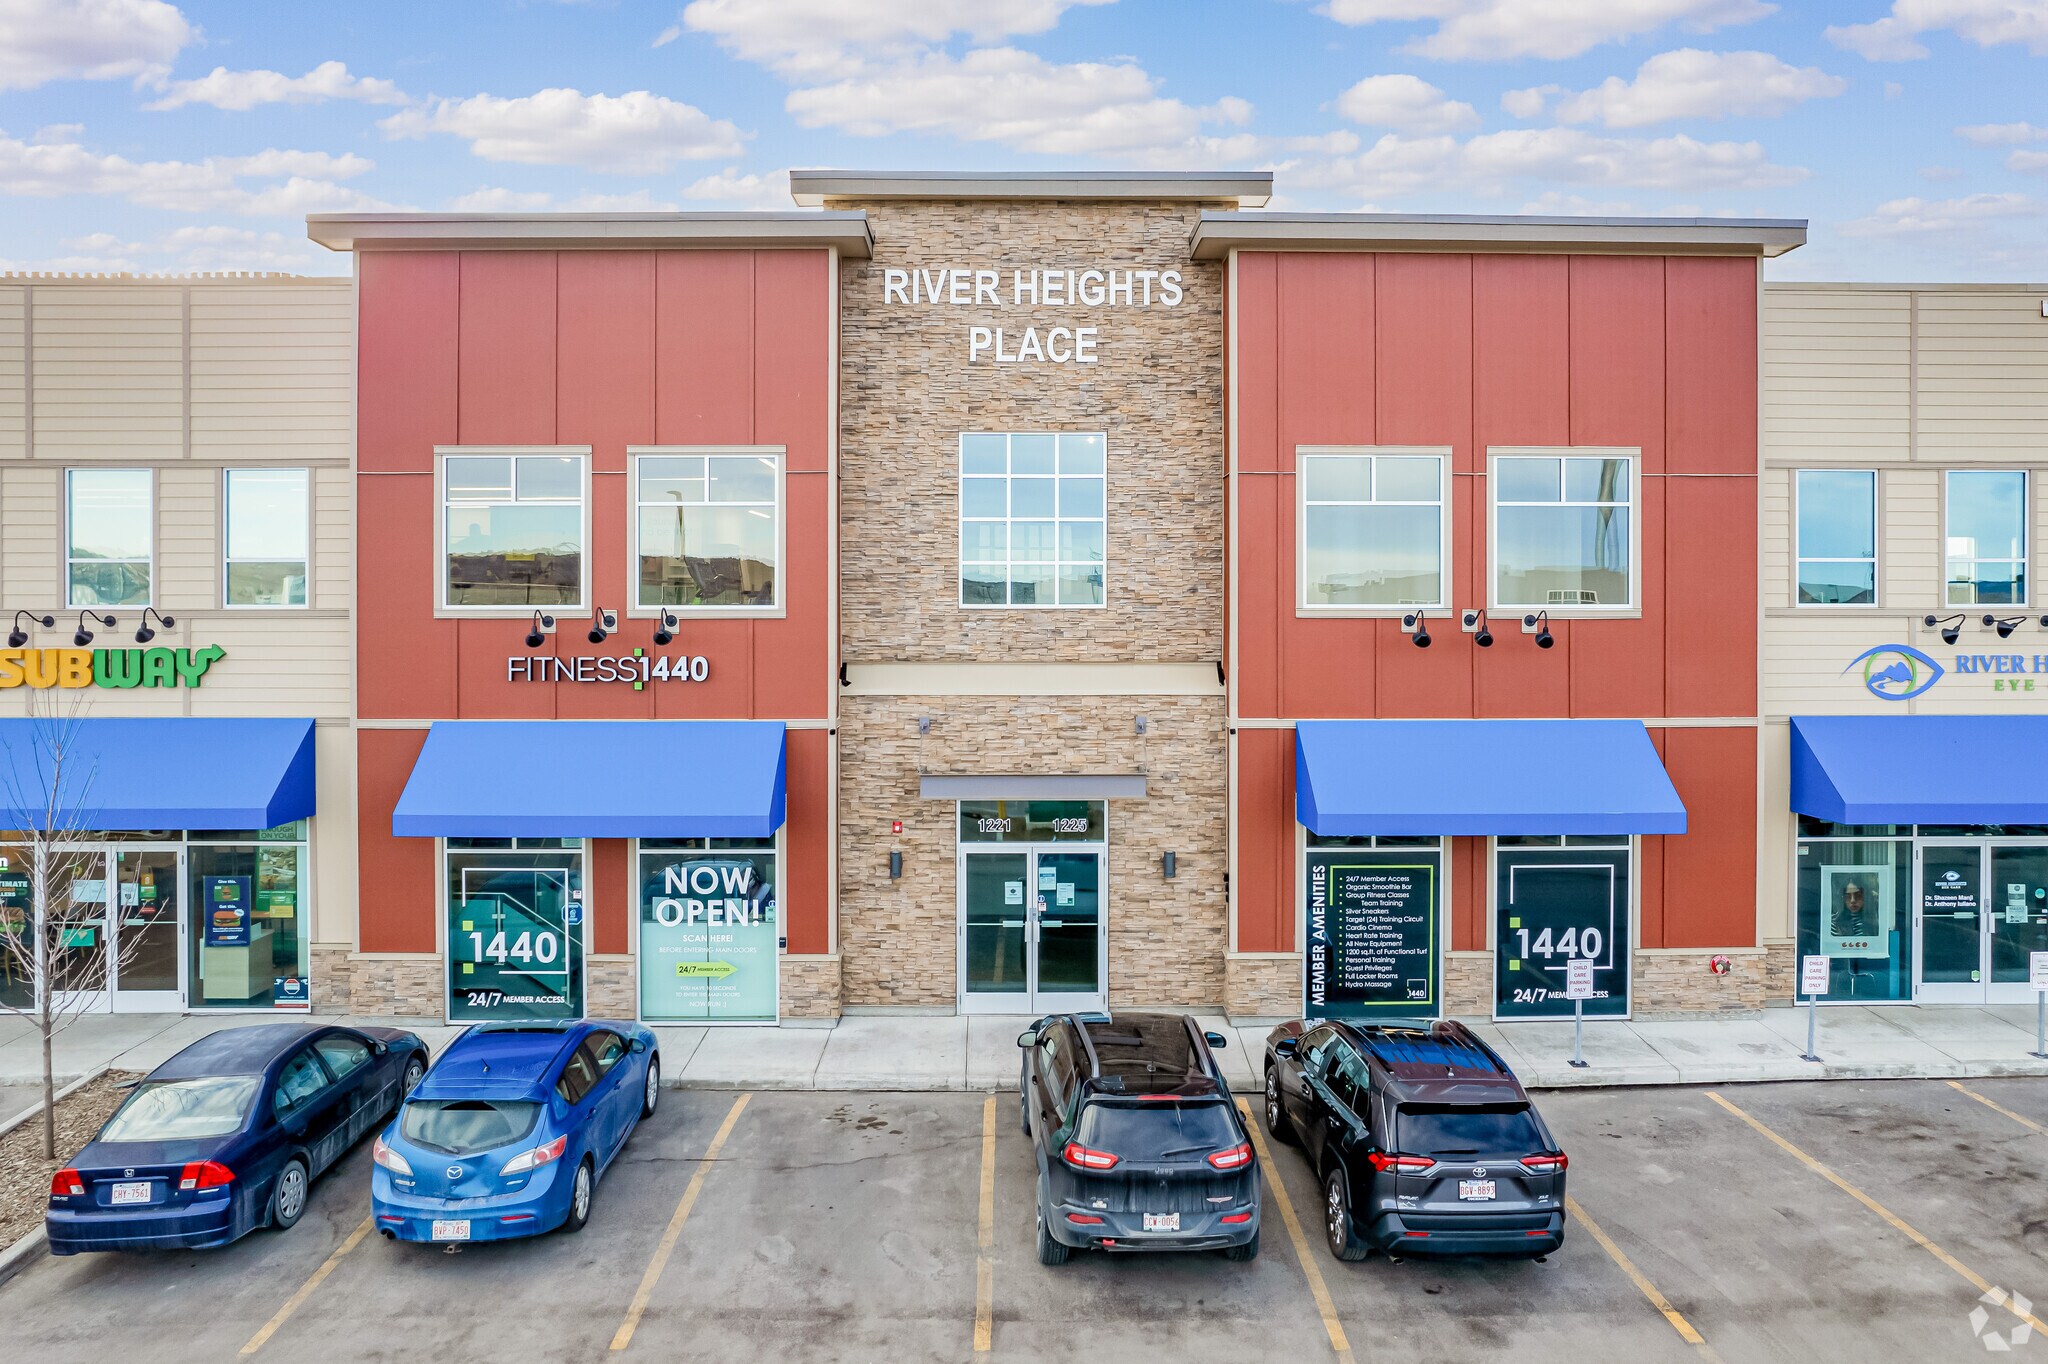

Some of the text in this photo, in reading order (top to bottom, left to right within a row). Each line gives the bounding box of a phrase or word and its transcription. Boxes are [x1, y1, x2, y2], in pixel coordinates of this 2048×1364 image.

[884, 268, 1183, 306] RIVER HEIGHTS
[969, 326, 1098, 363] PLACE
[0, 645, 227, 688] SUBWAY
[1955, 654, 2026, 673] RIVER
[1993, 679, 2035, 691] EYE
[977, 818, 1011, 832] 1221
[1052, 818, 1087, 832] 1225
[665, 866, 752, 895] NOW
[656, 898, 760, 928] OPEN!
[683, 934, 733, 942] SCAN HERE!
[1312, 865, 1326, 1007] MEMBER AMENITIES
[1516, 927, 1603, 959] 1440
[469, 931, 558, 964] 1440
[678, 966, 697, 974] 24/7
[467, 992, 565, 1008] 24/7 MEMBER ACCESS
[1513, 988, 1547, 1004] 24/7
[1592, 990, 1609, 998] CESS
[1154, 1166, 1174, 1175] Jeep
[113, 1188, 149, 1199] CHY-7561
[1460, 1185, 1495, 1196] BGW-8893
[433, 1225, 469, 1235] BVP-7450
